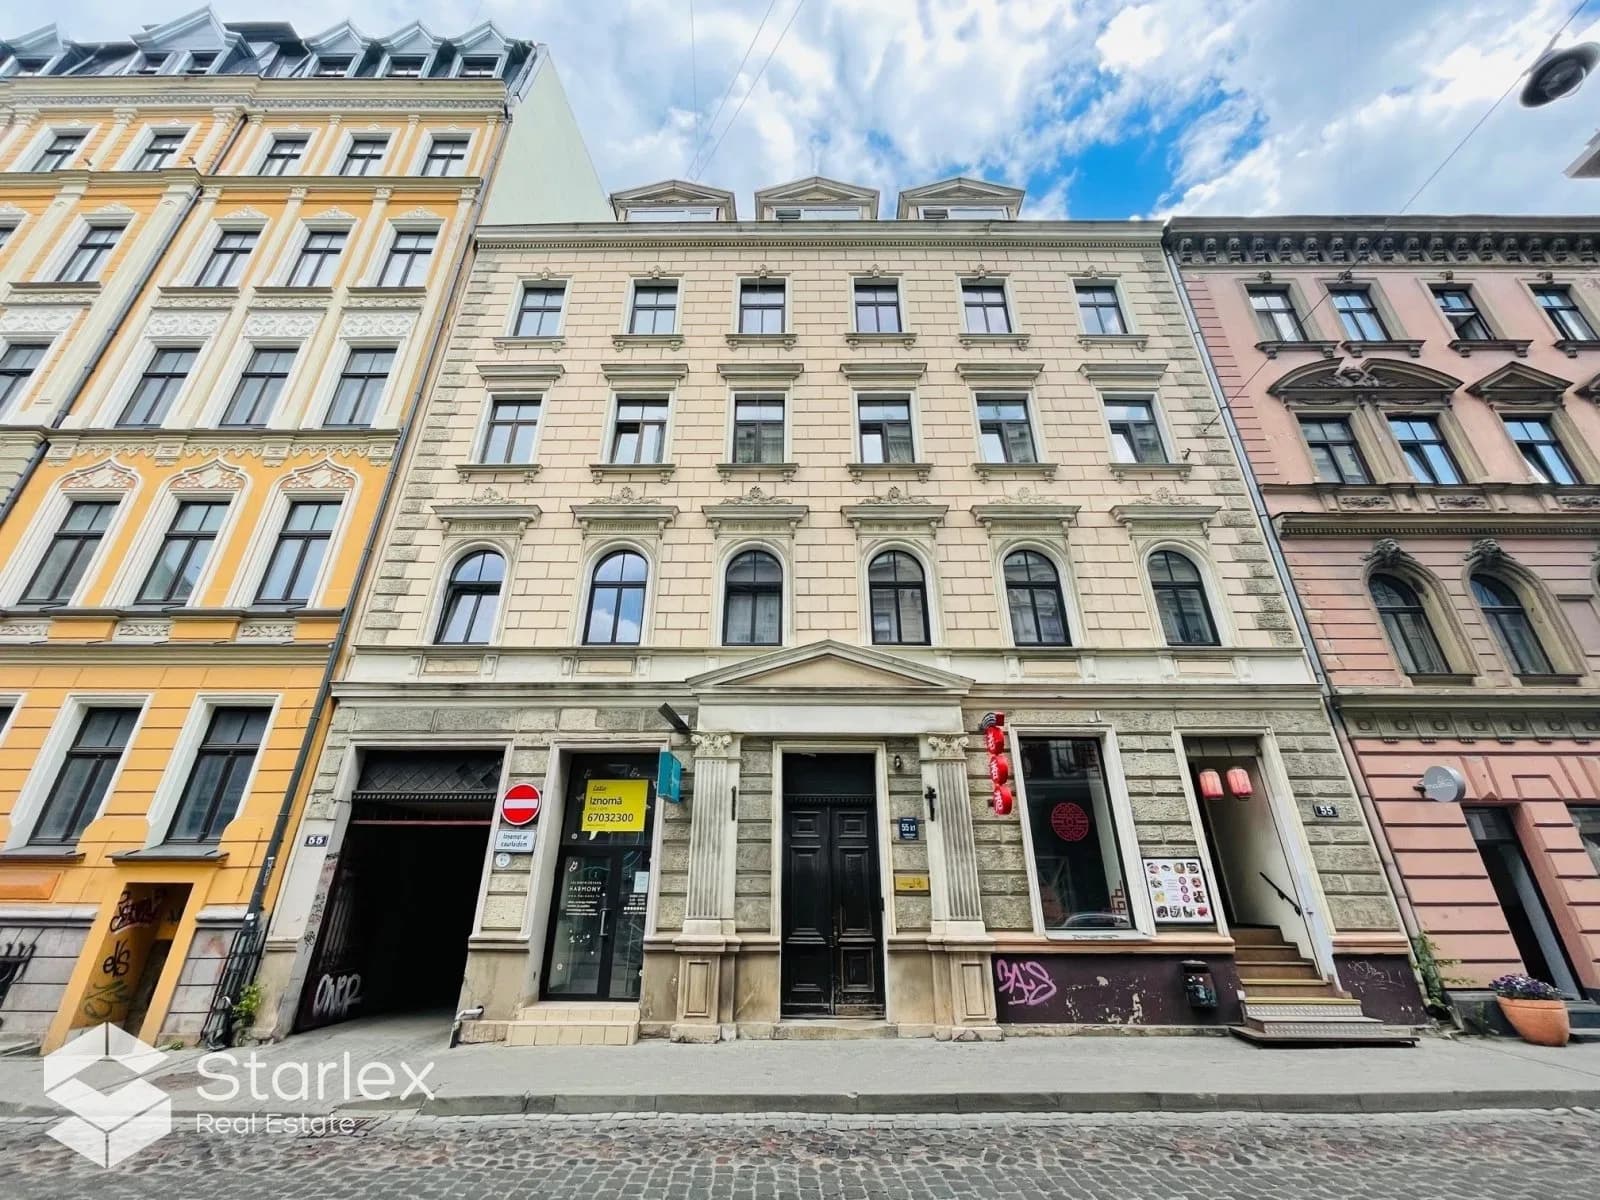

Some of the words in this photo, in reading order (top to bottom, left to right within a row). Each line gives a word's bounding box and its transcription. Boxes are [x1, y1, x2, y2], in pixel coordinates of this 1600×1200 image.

[1320, 806, 1333, 816] 55
[587, 813, 634, 822] 67032300
[901, 823, 910, 832] 55
[308, 836, 323, 845] 55
